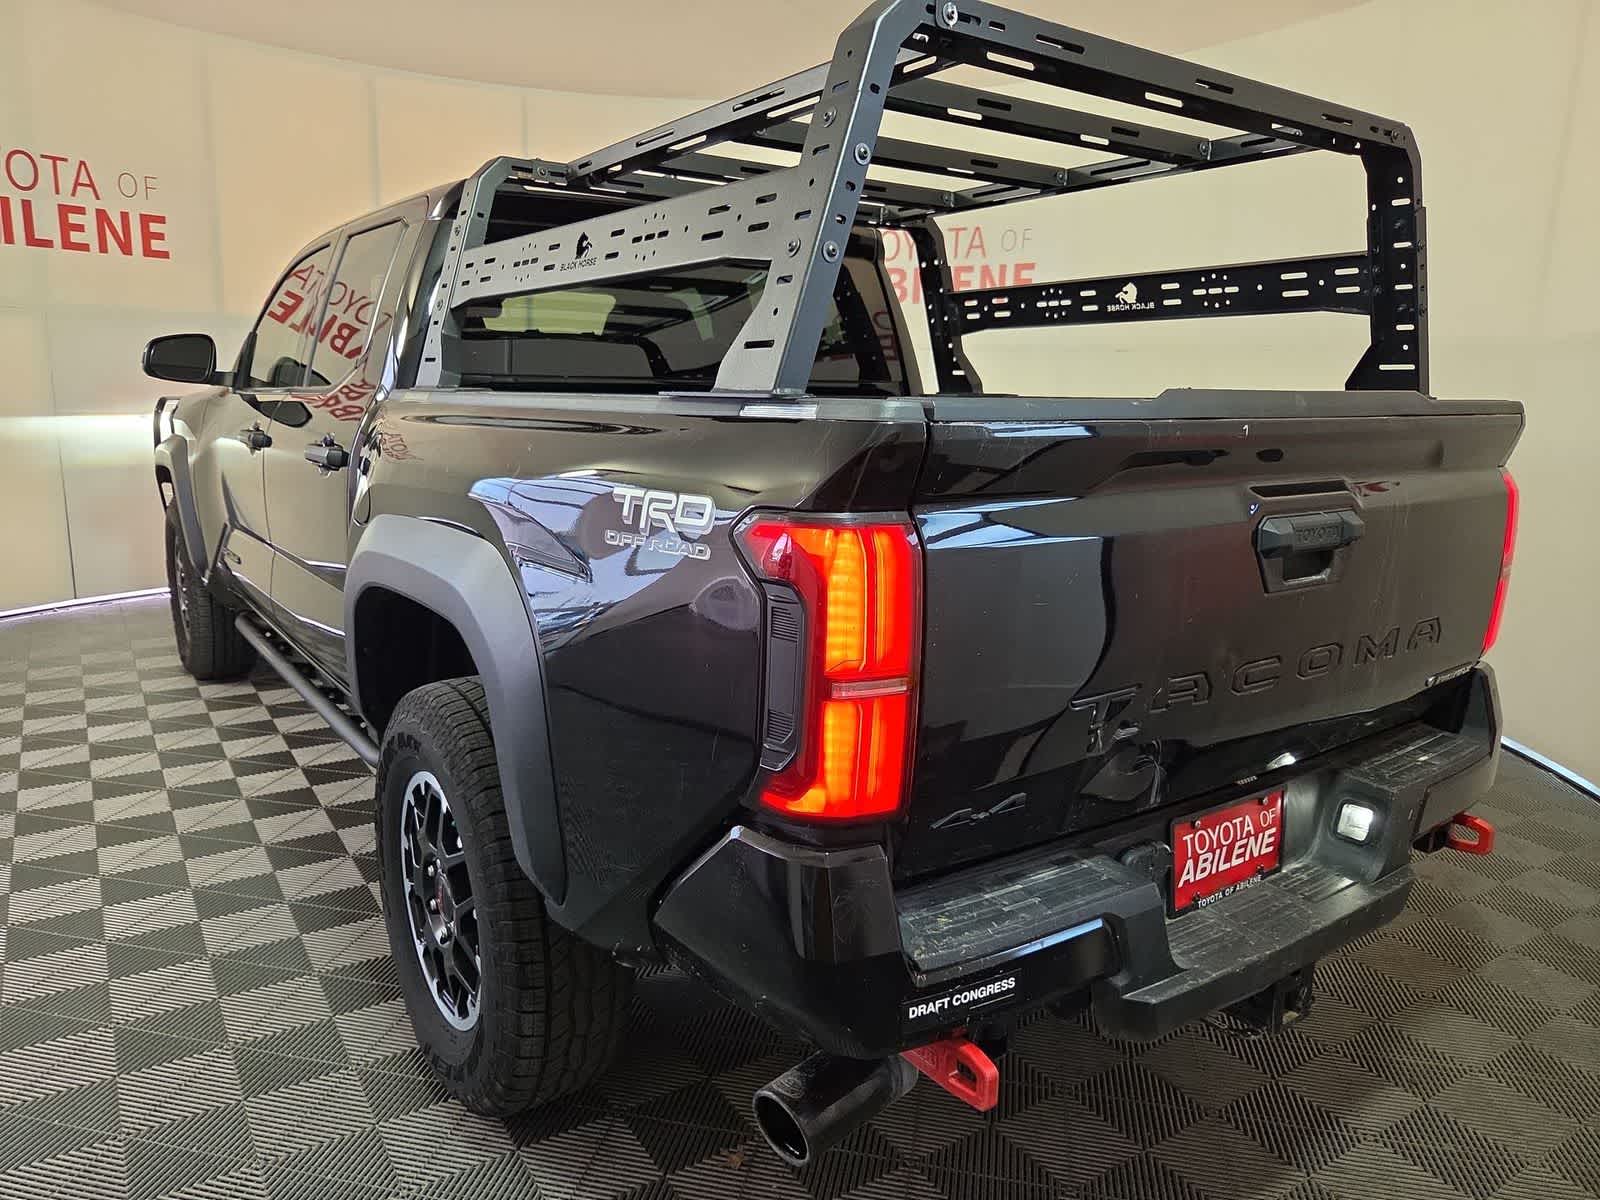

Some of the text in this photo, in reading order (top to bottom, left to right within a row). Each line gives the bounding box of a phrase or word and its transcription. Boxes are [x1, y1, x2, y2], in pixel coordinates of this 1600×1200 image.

[0, 149, 158, 200] OTA OF
[1001, 228, 1033, 252] OF
[612, 486, 716, 538] TRD
[604, 529, 712, 560] OFF ROAD
[1068, 616, 1442, 744] TACOMA
[1177, 827, 1277, 889] ABILENE
[1182, 807, 1277, 858] TOYOTA OF
[1198, 891, 1223, 908] TOYOTA
[1224, 886, 1234, 896] OF
[909, 977, 1016, 1019] DRAFT CONGRESS
